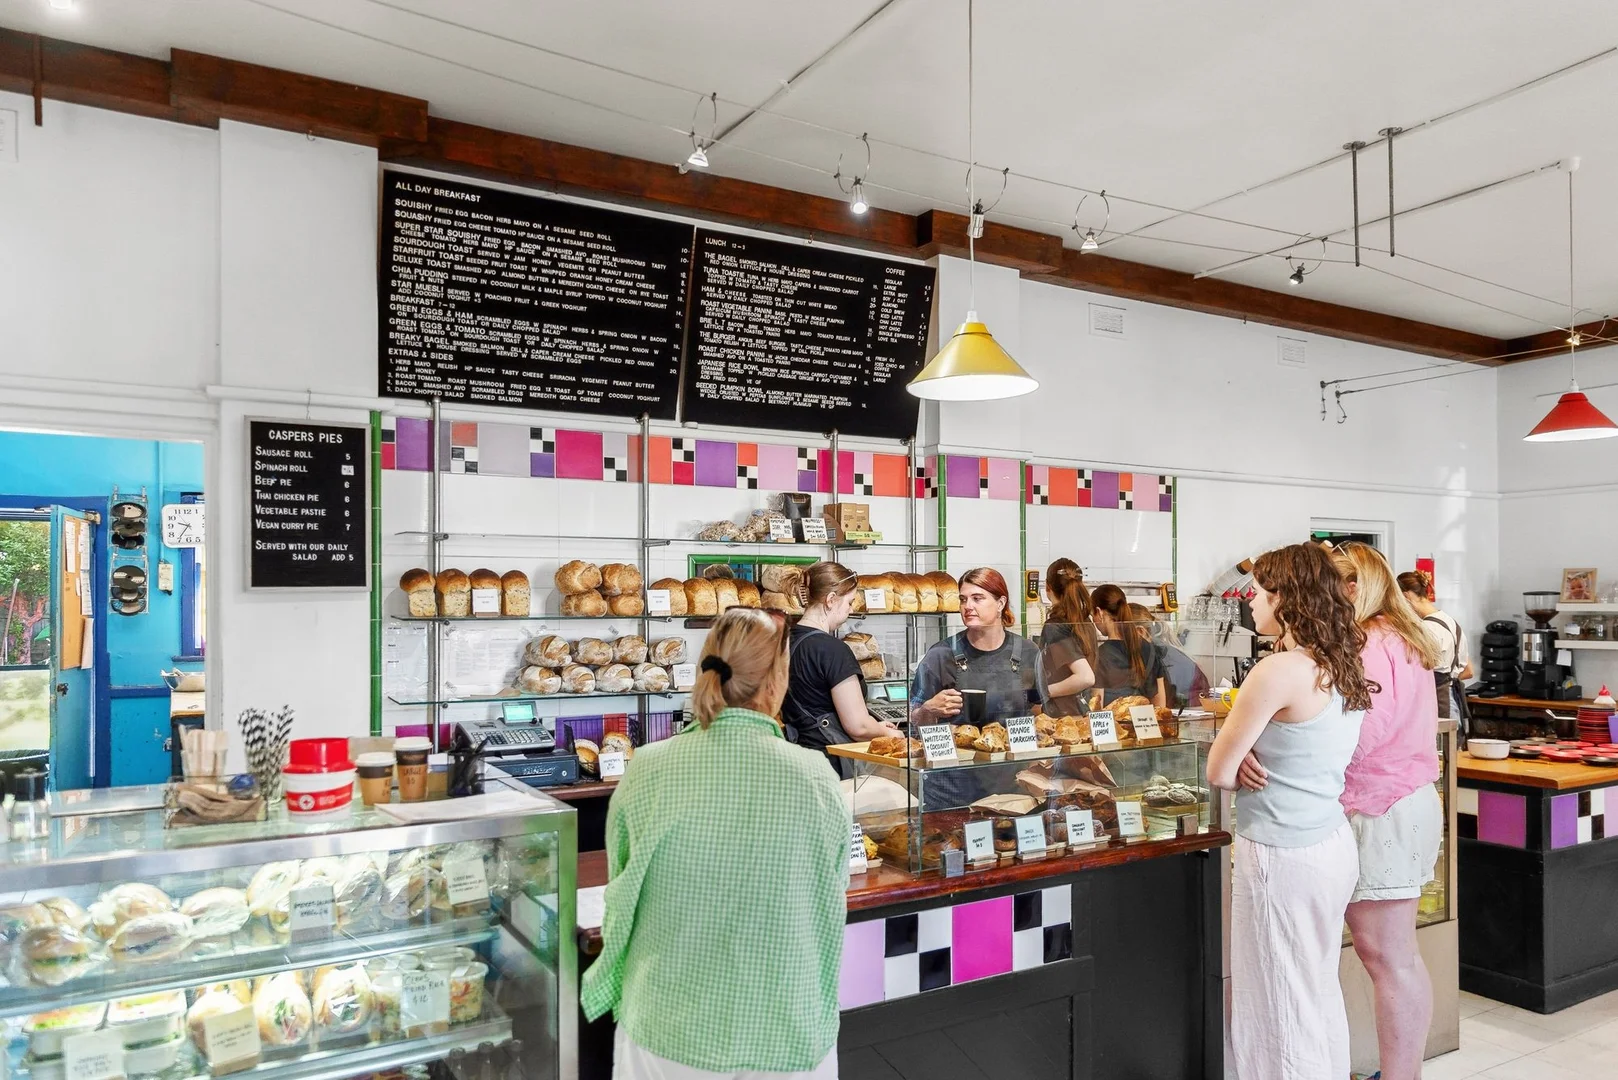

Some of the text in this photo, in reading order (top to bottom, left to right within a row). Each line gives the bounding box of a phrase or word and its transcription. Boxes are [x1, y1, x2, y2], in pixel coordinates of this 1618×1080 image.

[396, 182, 480, 203] ALL DAY BREAKFAST
[395, 209, 432, 222] SQUASHY
[395, 198, 432, 211] SQUISHY
[435, 206, 453, 215] FRIED
[471, 212, 493, 221] BACON
[496, 216, 511, 224] HERB
[553, 226, 575, 235] SESAME
[395, 221, 481, 241] SUPER STAR SQUISHY
[705, 237, 726, 247] LUNCH
[393, 245, 464, 262] STARFRUIT TOAST
[394, 236, 445, 250] SOURDOUGH
[448, 244, 473, 254] TOAST
[477, 250, 500, 258] SERVED
[532, 258, 551, 266] HONEY
[558, 262, 584, 271] VEGEMITE
[601, 268, 622, 276] PEANUT
[624, 272, 645, 280] BUTTER
[704, 252, 737, 263] THE BAGEL
[393, 254, 451, 269] DELUXE TOAST
[392, 265, 449, 279] CHIA PUDDING
[703, 266, 744, 278] TUNA TOASTIE
[885, 267, 905, 276] COFFEE
[391, 280, 443, 293] STAR MUESLI
[702, 285, 715, 293] HAM
[390, 295, 434, 306] BREAKFAST
[389, 303, 417, 313] GREEN
[421, 307, 443, 316] EGGS
[455, 311, 473, 319] HAM
[701, 299, 772, 315] ROAST VEGETABLE PANINI
[389, 317, 416, 327] GREEN
[420, 321, 442, 330] EGGS
[454, 325, 486, 335] TOMATO
[389, 332, 449, 345] BREAKY BAGEL
[713, 333, 735, 341] BURGER
[388, 348, 419, 357] EXTRAS
[430, 352, 453, 361] SIDES
[698, 345, 765, 358] ROAST CHICKEN PANINI
[697, 359, 725, 368] JAPANESE
[696, 382, 717, 390] SEEDED
[720, 384, 745, 392] PUMPKIN
[471, 393, 496, 401] SMOKED
[269, 430, 342, 444] CASPERS PIES
[255, 446, 290, 457] SAUSAGE
[255, 460, 288, 472] SPINACH
[255, 489, 271, 500] THAI
[274, 493, 305, 501] CHICKEN
[255, 505, 298, 515] VEGETABLE
[301, 508, 326, 516] PASTIE
[256, 519, 279, 529] VEGAN
[281, 522, 304, 530] CURRY
[255, 540, 286, 550] SERVED
[309, 543, 324, 551] OUR
[328, 543, 348, 551] DAILY
[293, 553, 317, 561] SALAD
[1010, 726, 1030, 734] ORANGE
